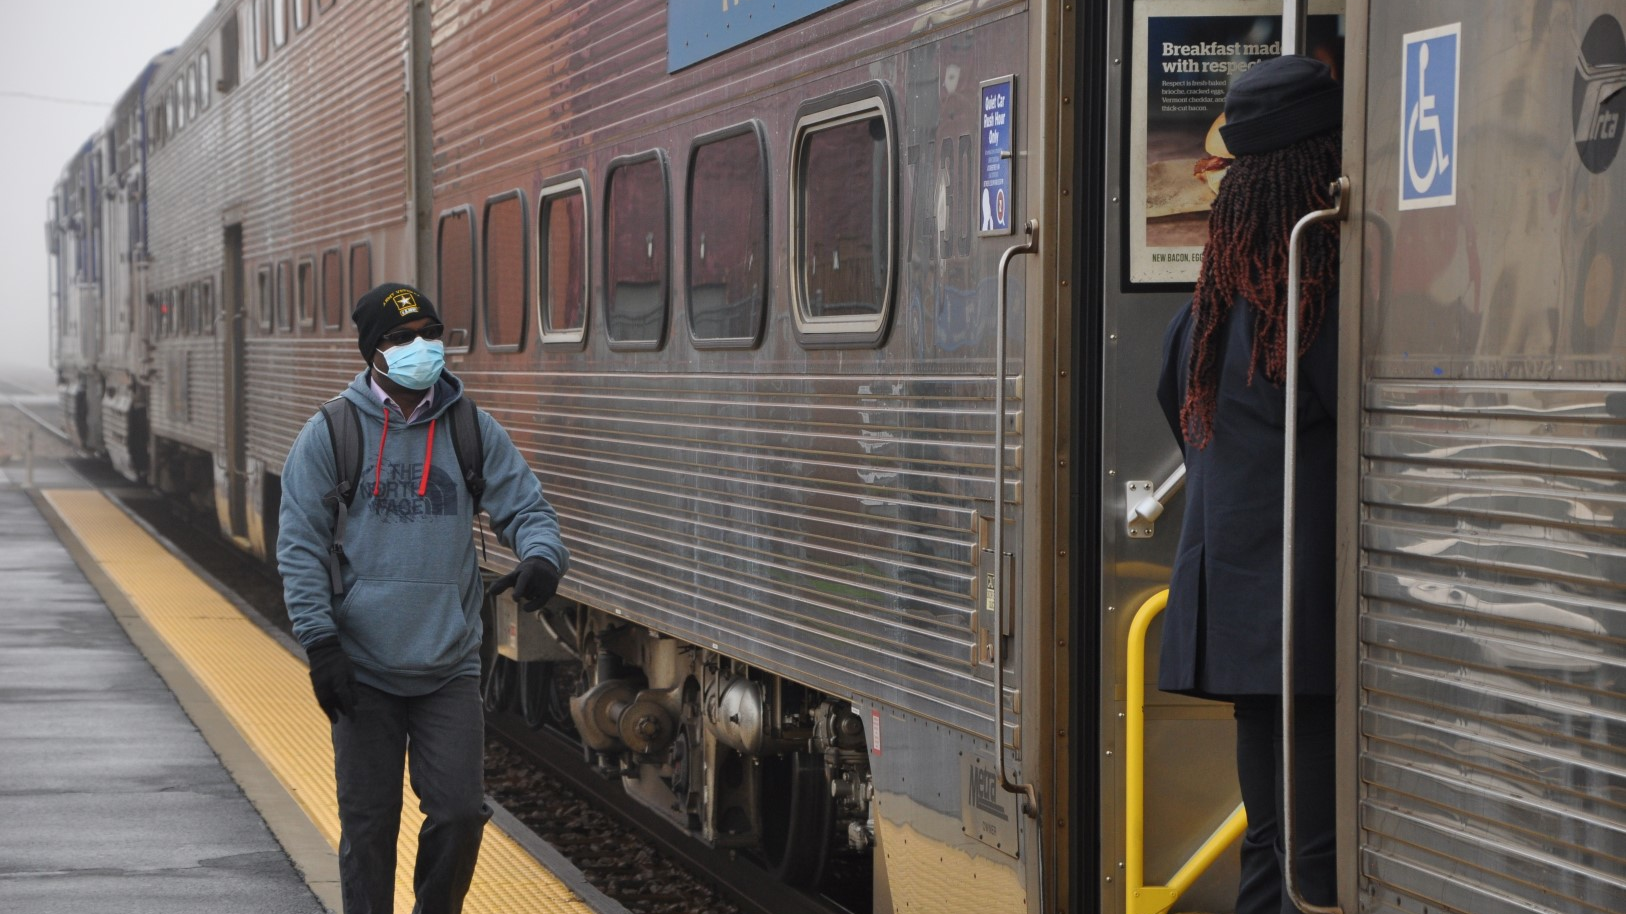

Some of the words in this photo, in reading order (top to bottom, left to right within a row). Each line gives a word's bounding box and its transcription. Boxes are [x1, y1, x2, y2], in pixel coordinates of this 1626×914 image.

[1162, 42, 1241, 56] Breakfast
[1243, 41, 1282, 55] mad
[1162, 59, 1199, 73] with
[985, 94, 997, 111] Quiet
[997, 93, 1005, 108] Car
[984, 112, 995, 128] Rush
[995, 111, 1006, 126] Hour
[989, 129, 999, 146] Only
[1152, 253, 1167, 262] NEW
[1167, 253, 1191, 262] BACON,
[388, 463, 424, 480] THE
[968, 764, 997, 807] Metra
